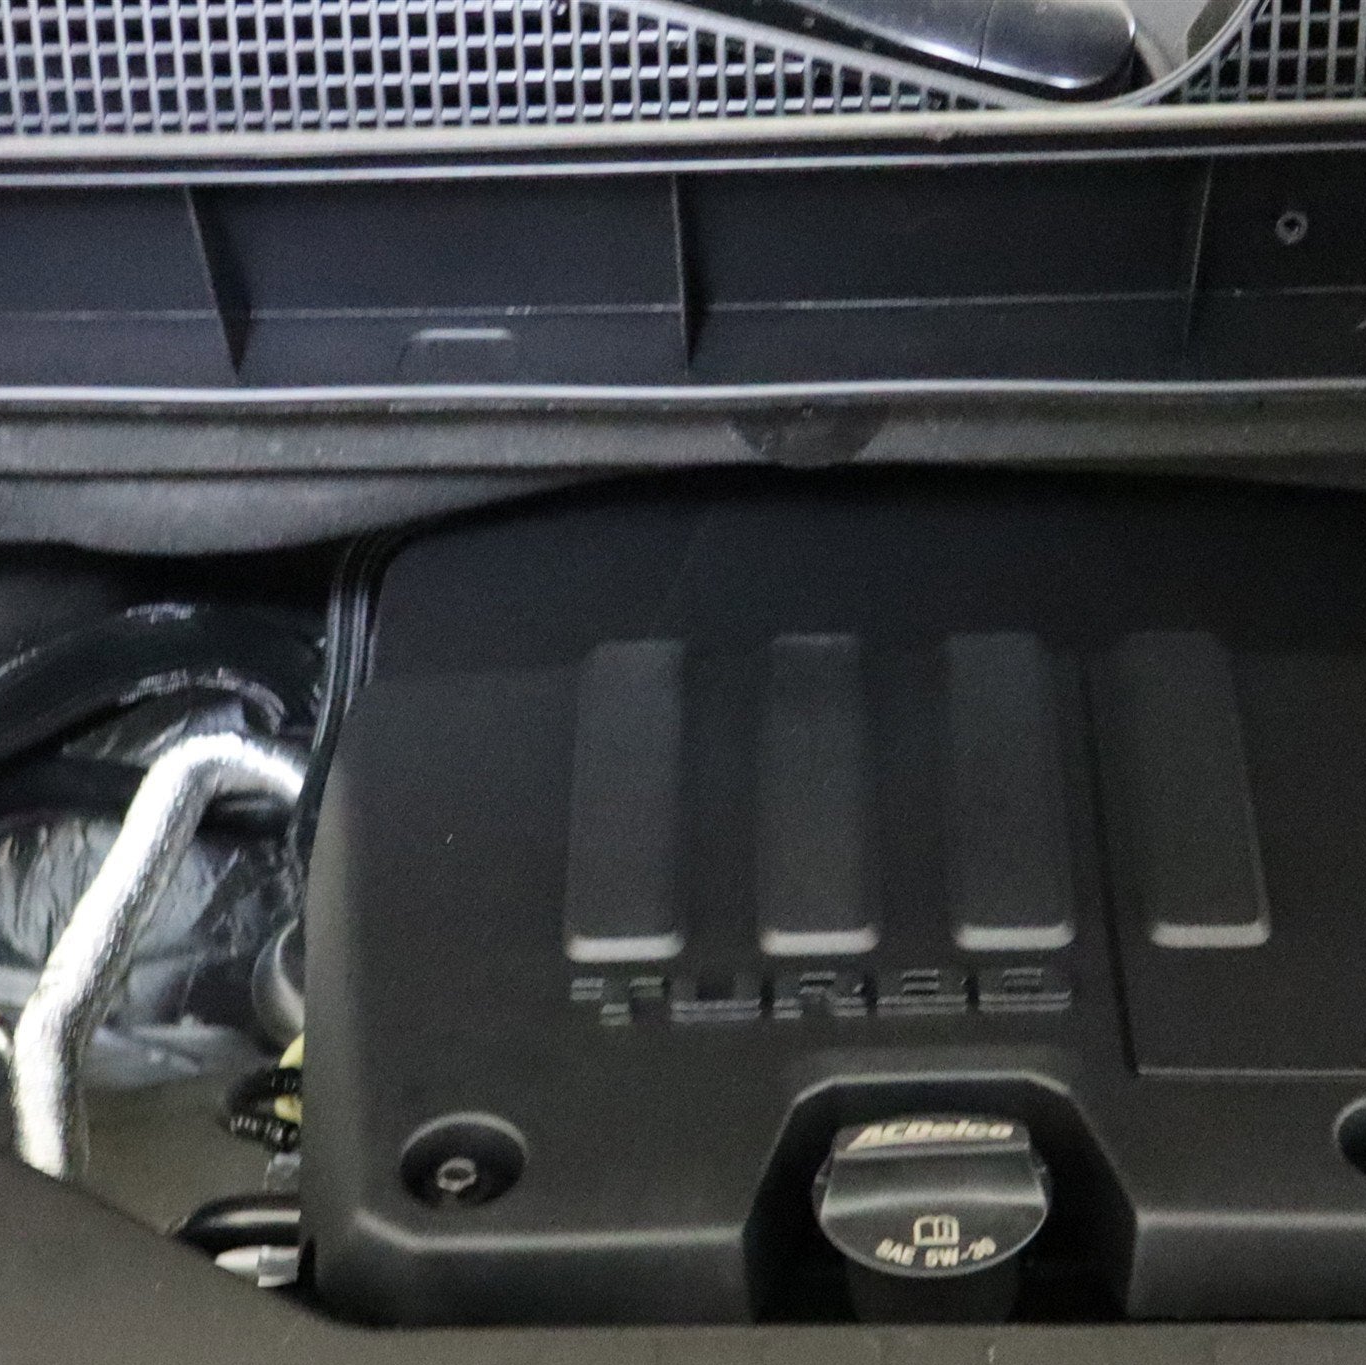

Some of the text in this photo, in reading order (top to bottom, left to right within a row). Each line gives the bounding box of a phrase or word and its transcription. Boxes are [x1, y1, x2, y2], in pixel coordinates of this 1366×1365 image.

[569, 961, 1073, 1026] TURBO
[848, 1119, 1015, 1149] ACDelco
[876, 1237, 917, 1266] SAE
